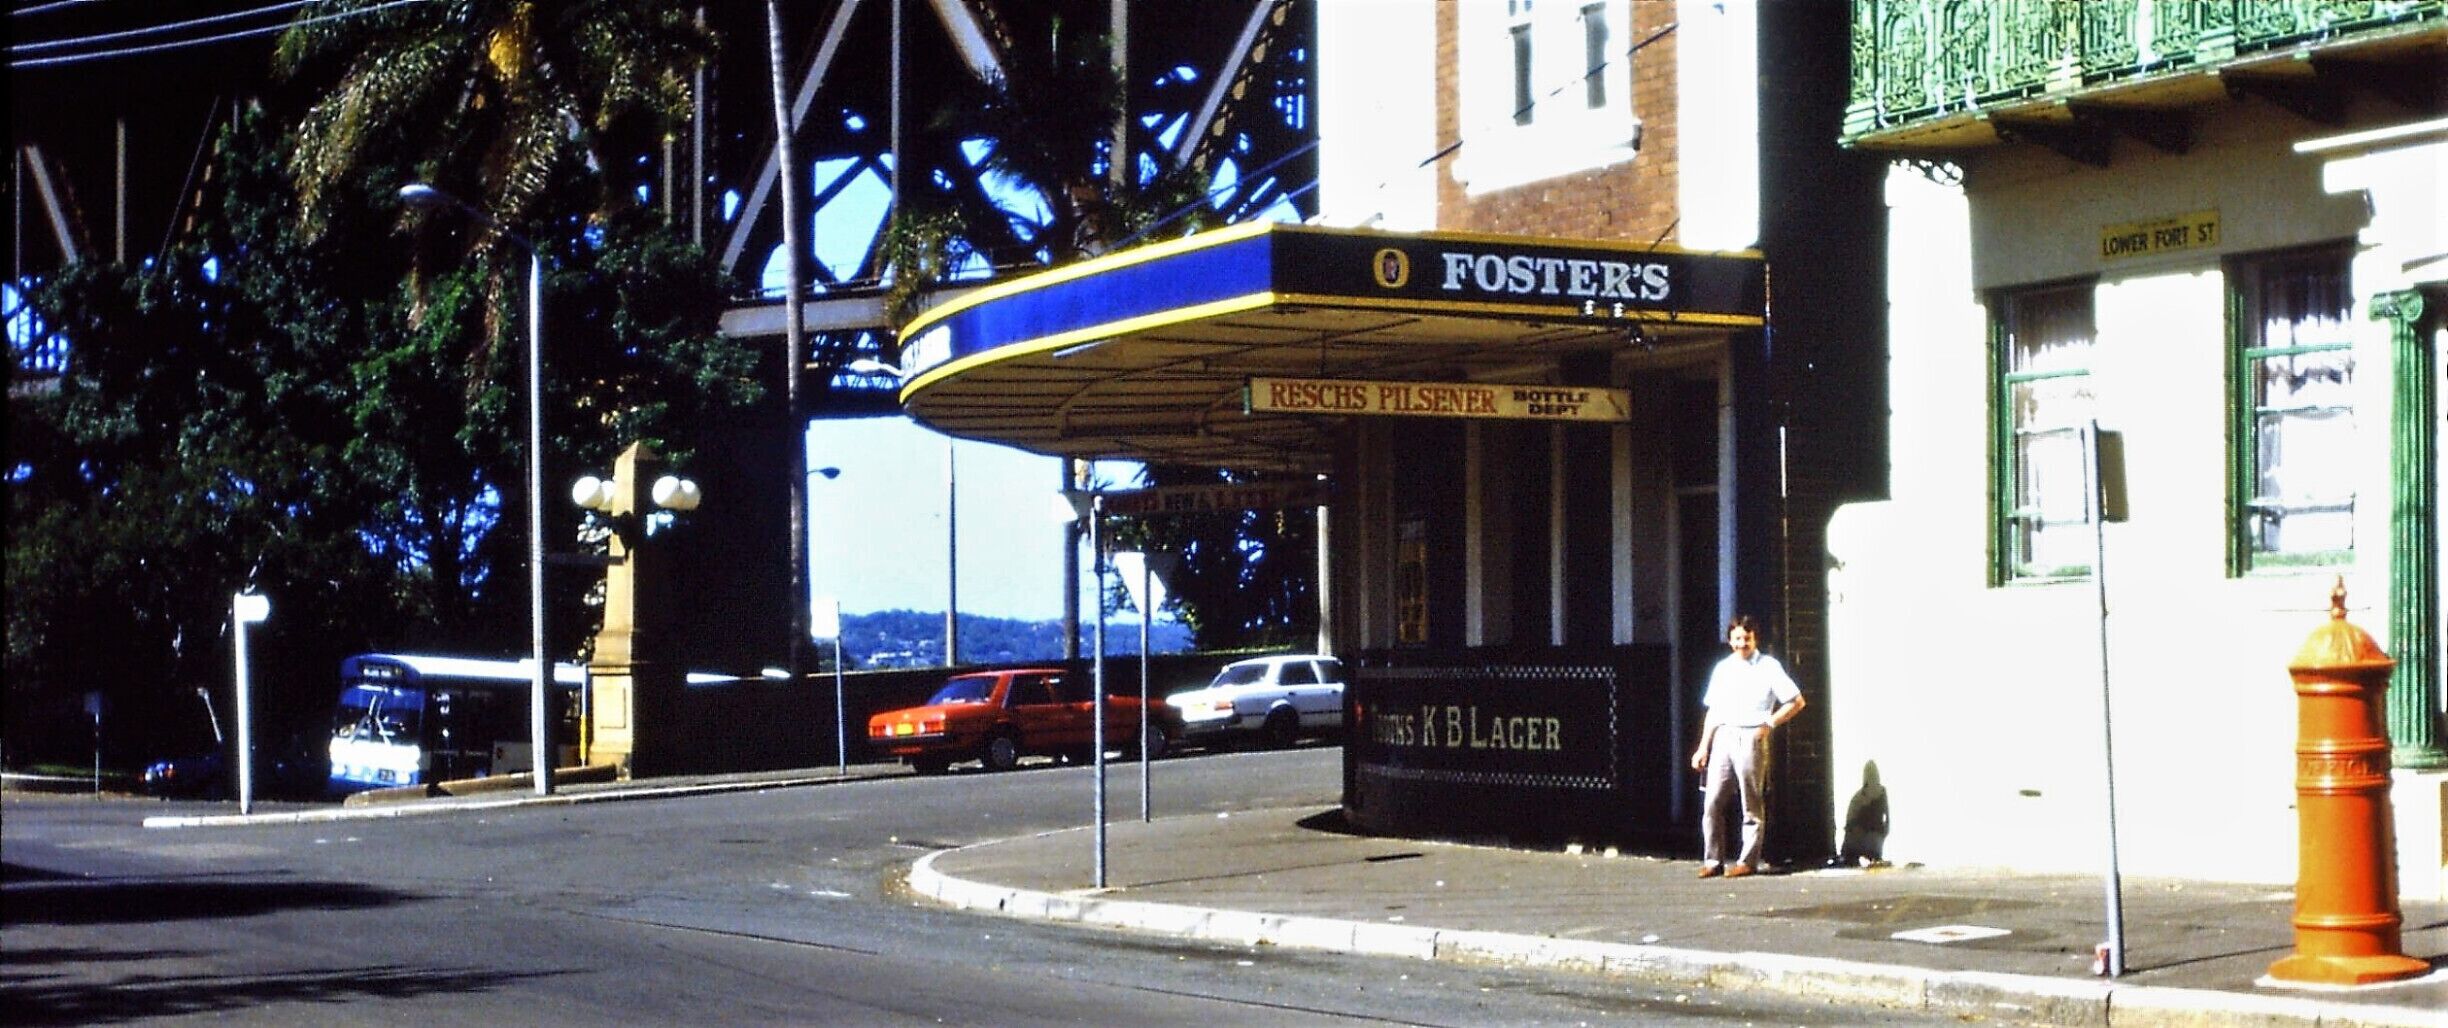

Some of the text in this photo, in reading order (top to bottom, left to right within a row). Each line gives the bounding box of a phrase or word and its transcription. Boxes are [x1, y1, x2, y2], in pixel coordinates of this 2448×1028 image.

[2103, 234, 2147, 257] LOWER
[2155, 226, 2189, 248] FORT
[2198, 223, 2214, 242] ST
[1442, 252, 1670, 301] FOSTER'S
[1270, 382, 1498, 415] RESCHS PILSENER
[1513, 390, 1590, 402] BOTTLE
[1529, 403, 1580, 414] DEPT
[1470, 706, 1561, 751] LAGER
